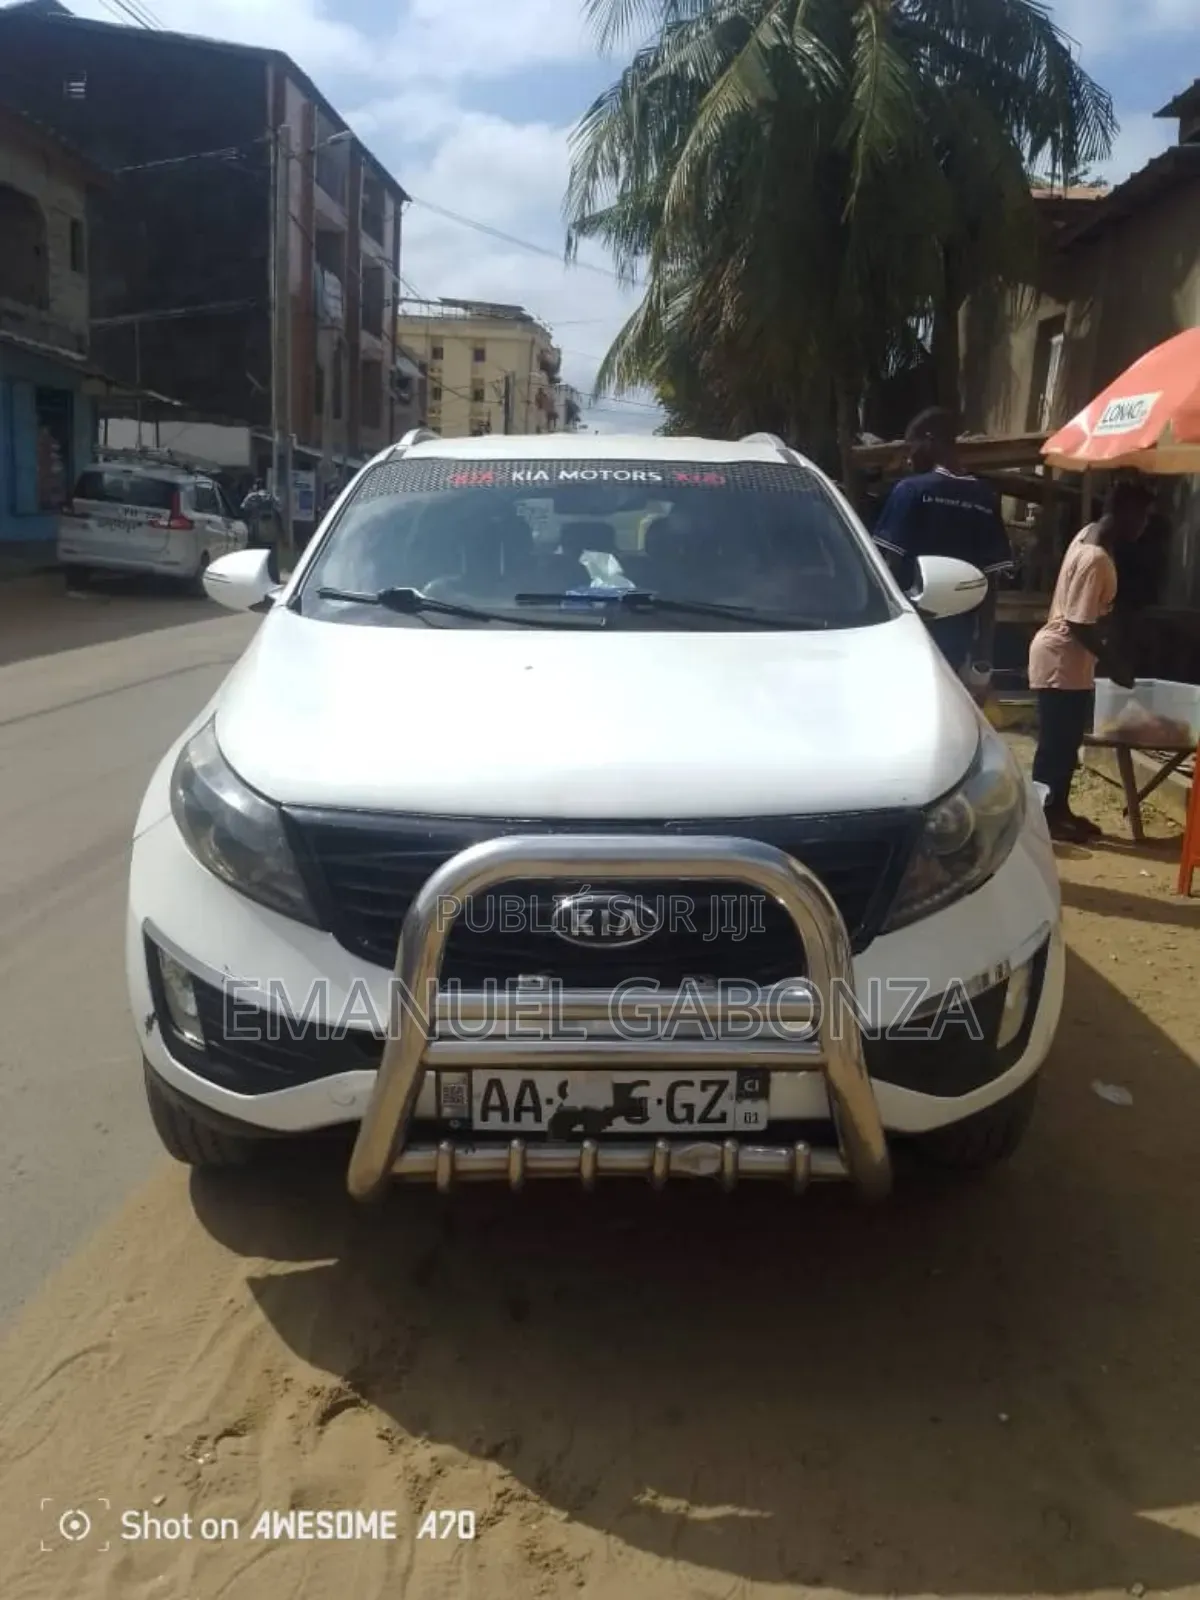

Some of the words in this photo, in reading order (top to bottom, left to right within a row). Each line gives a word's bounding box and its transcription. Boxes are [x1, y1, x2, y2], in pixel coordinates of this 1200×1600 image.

[511, 470, 550, 482] KIA
[558, 469, 663, 482] MOTORS
[571, 909, 641, 936] KIA
